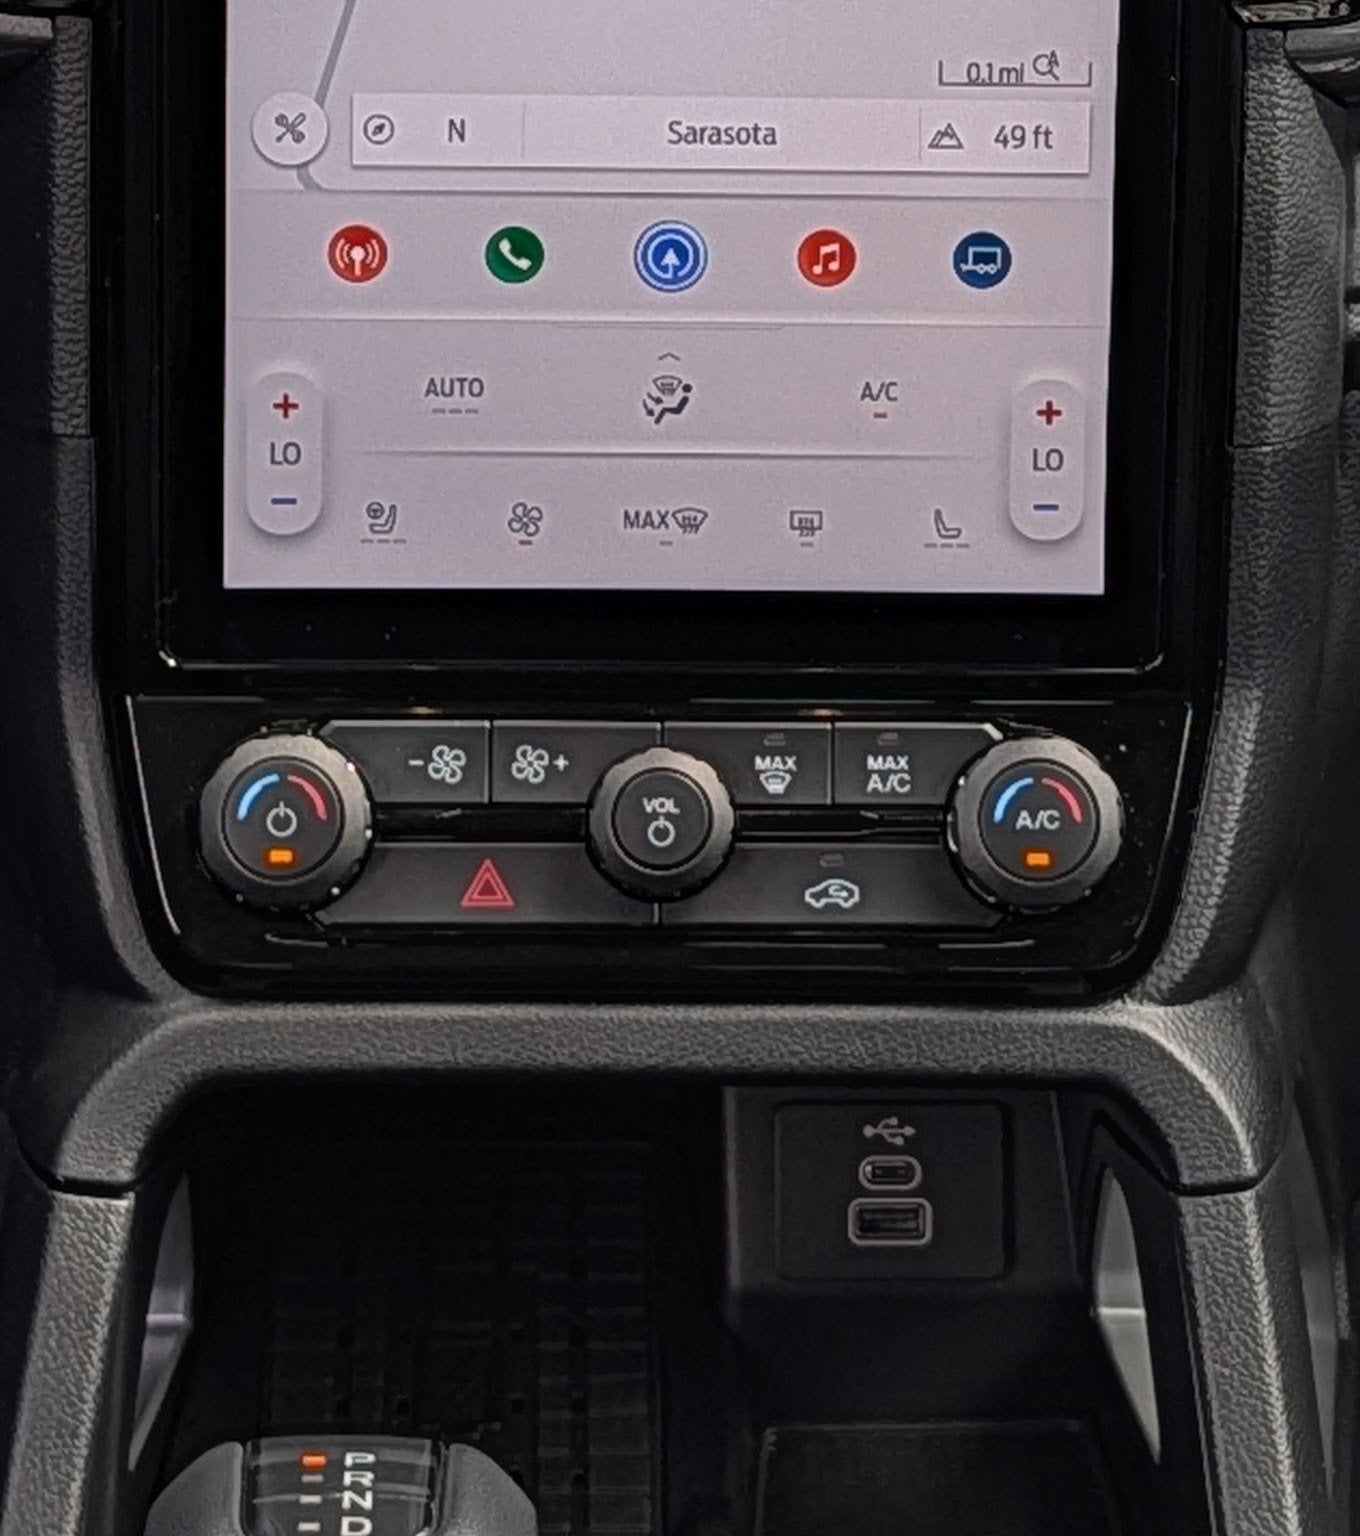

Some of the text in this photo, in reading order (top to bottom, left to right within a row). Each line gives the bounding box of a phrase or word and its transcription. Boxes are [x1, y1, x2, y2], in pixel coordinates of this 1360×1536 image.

[447, 118, 1055, 151] N Sarasota 49 ft
[424, 377, 485, 400] AUTO
[859, 381, 899, 403] A/C
[269, 442, 302, 466] LO
[1032, 448, 1065, 473] LO
[622, 509, 670, 531] MAX
[754, 755, 798, 772] MAX
[866, 754, 910, 771] MAX
[865, 773, 911, 795] A/C
[641, 797, 681, 816] VOL
[1014, 809, 1061, 832] A/C
[344, 1451, 377, 1468] P
[342, 1470, 375, 1489] R
[341, 1490, 374, 1511] N
[340, 1515, 374, 1536] D
